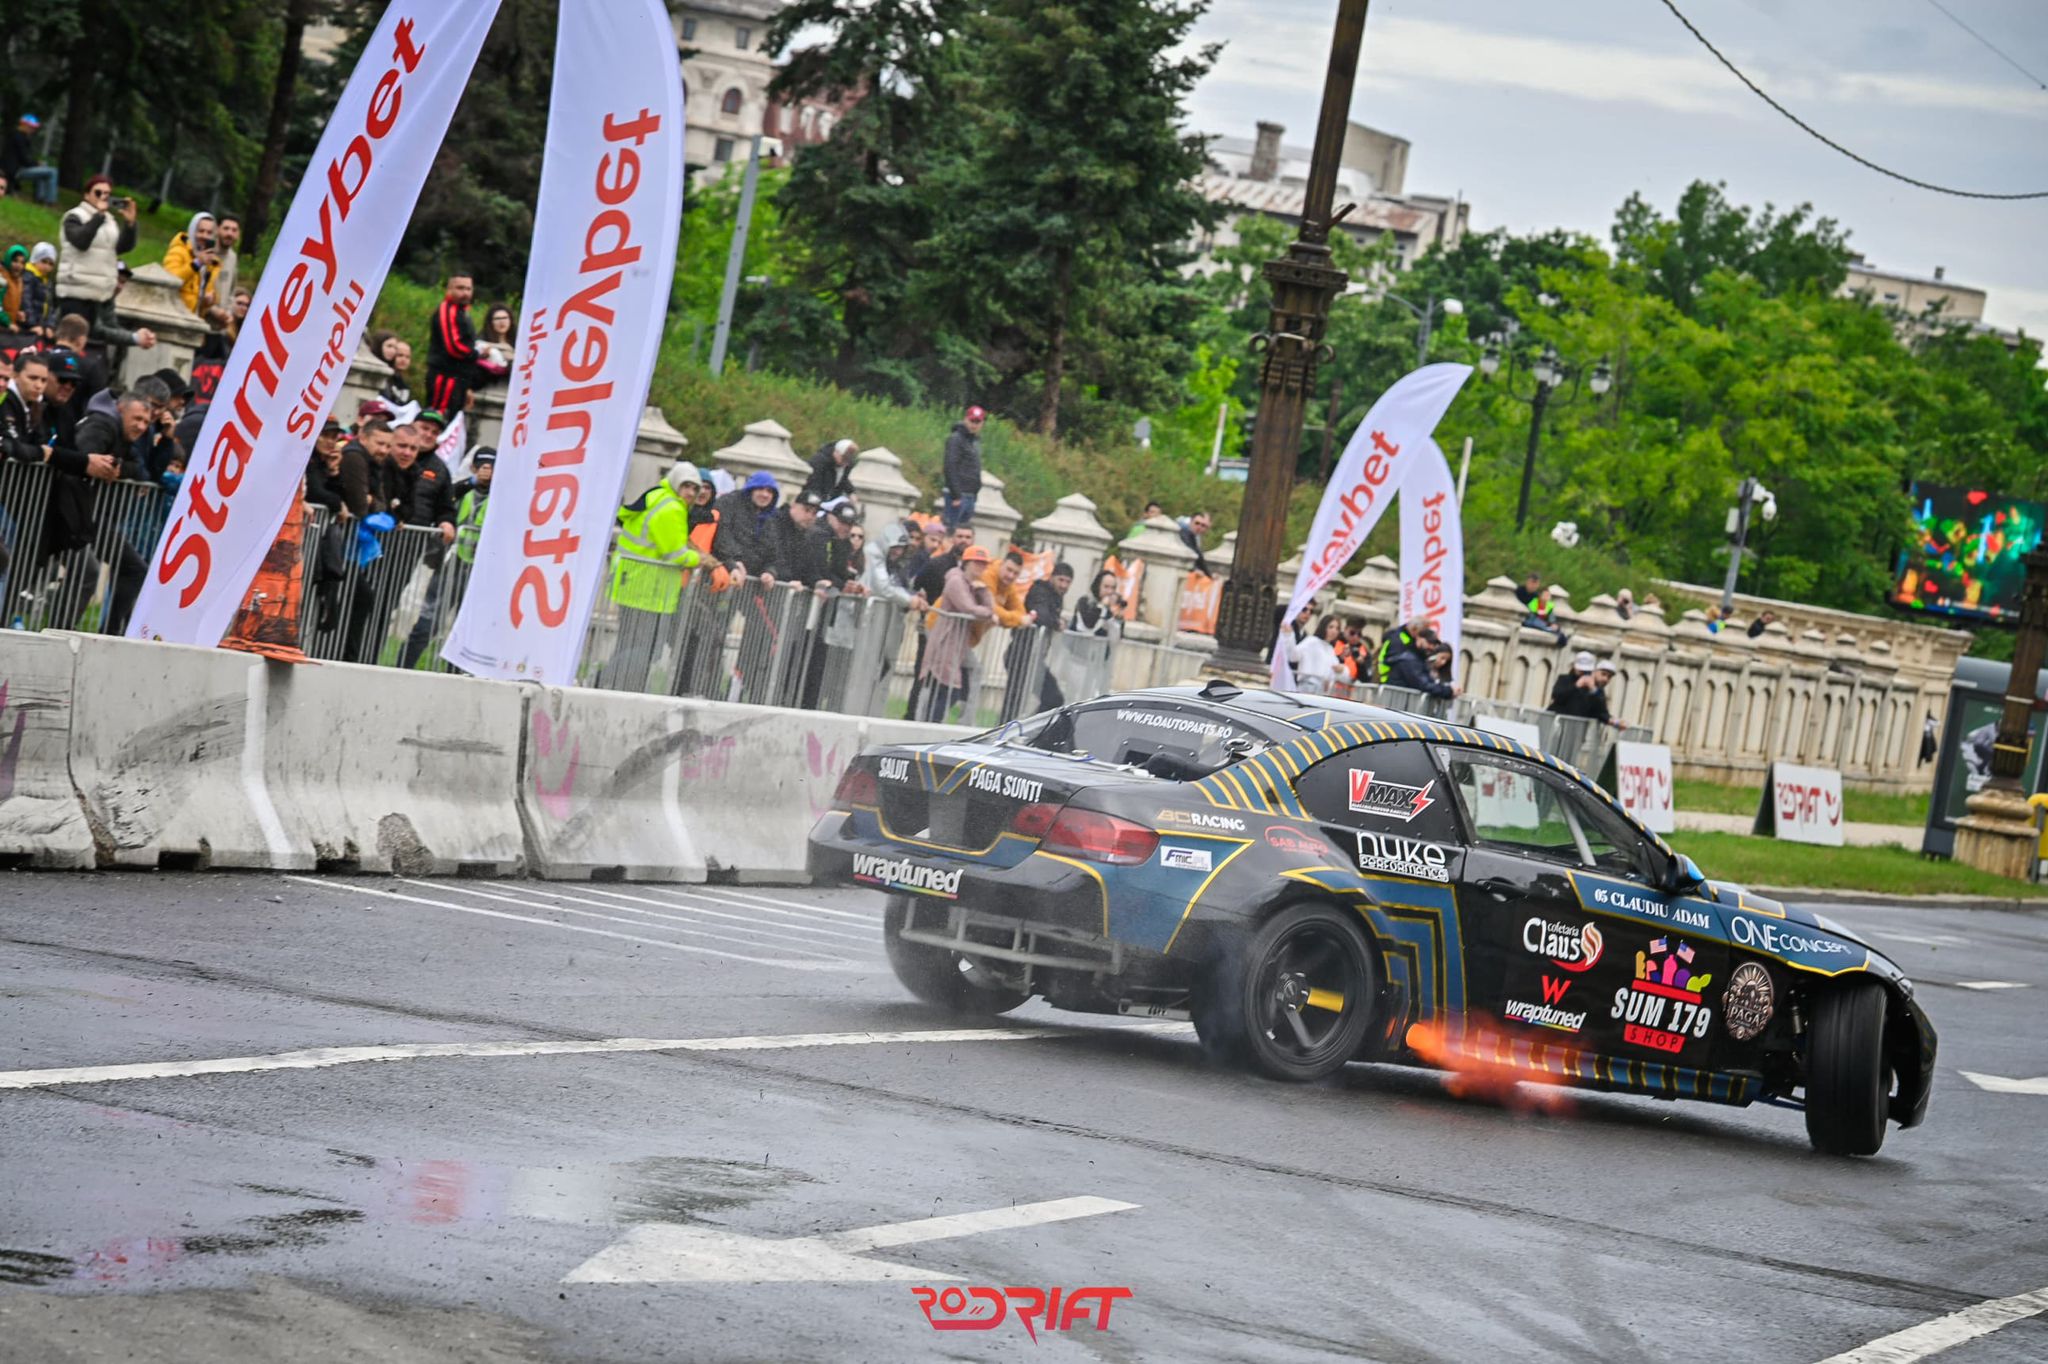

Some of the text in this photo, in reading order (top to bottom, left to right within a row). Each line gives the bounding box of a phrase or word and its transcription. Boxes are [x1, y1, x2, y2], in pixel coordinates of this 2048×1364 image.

[158, 16, 426, 609] Stanleybet
[286, 279, 365, 441] Simplu
[1116, 709, 1233, 738] WWW.FLOAUTOPARTS.RO
[878, 756, 910, 783] SALUT,
[968, 767, 1043, 803] PAGA SUNT!
[1350, 769, 1417, 809] VMAX
[1190, 812, 1246, 831] RACING
[1356, 831, 1446, 868] nuke
[853, 852, 965, 893] wraptuned
[1594, 888, 1711, 930] 05 CLAUDIU ADAM
[1523, 917, 1582, 961] Claus
[1505, 999, 1587, 1030] wraptuned
[1610, 987, 1712, 1039] SUM 179
[1629, 1027, 1680, 1048] SHOP
